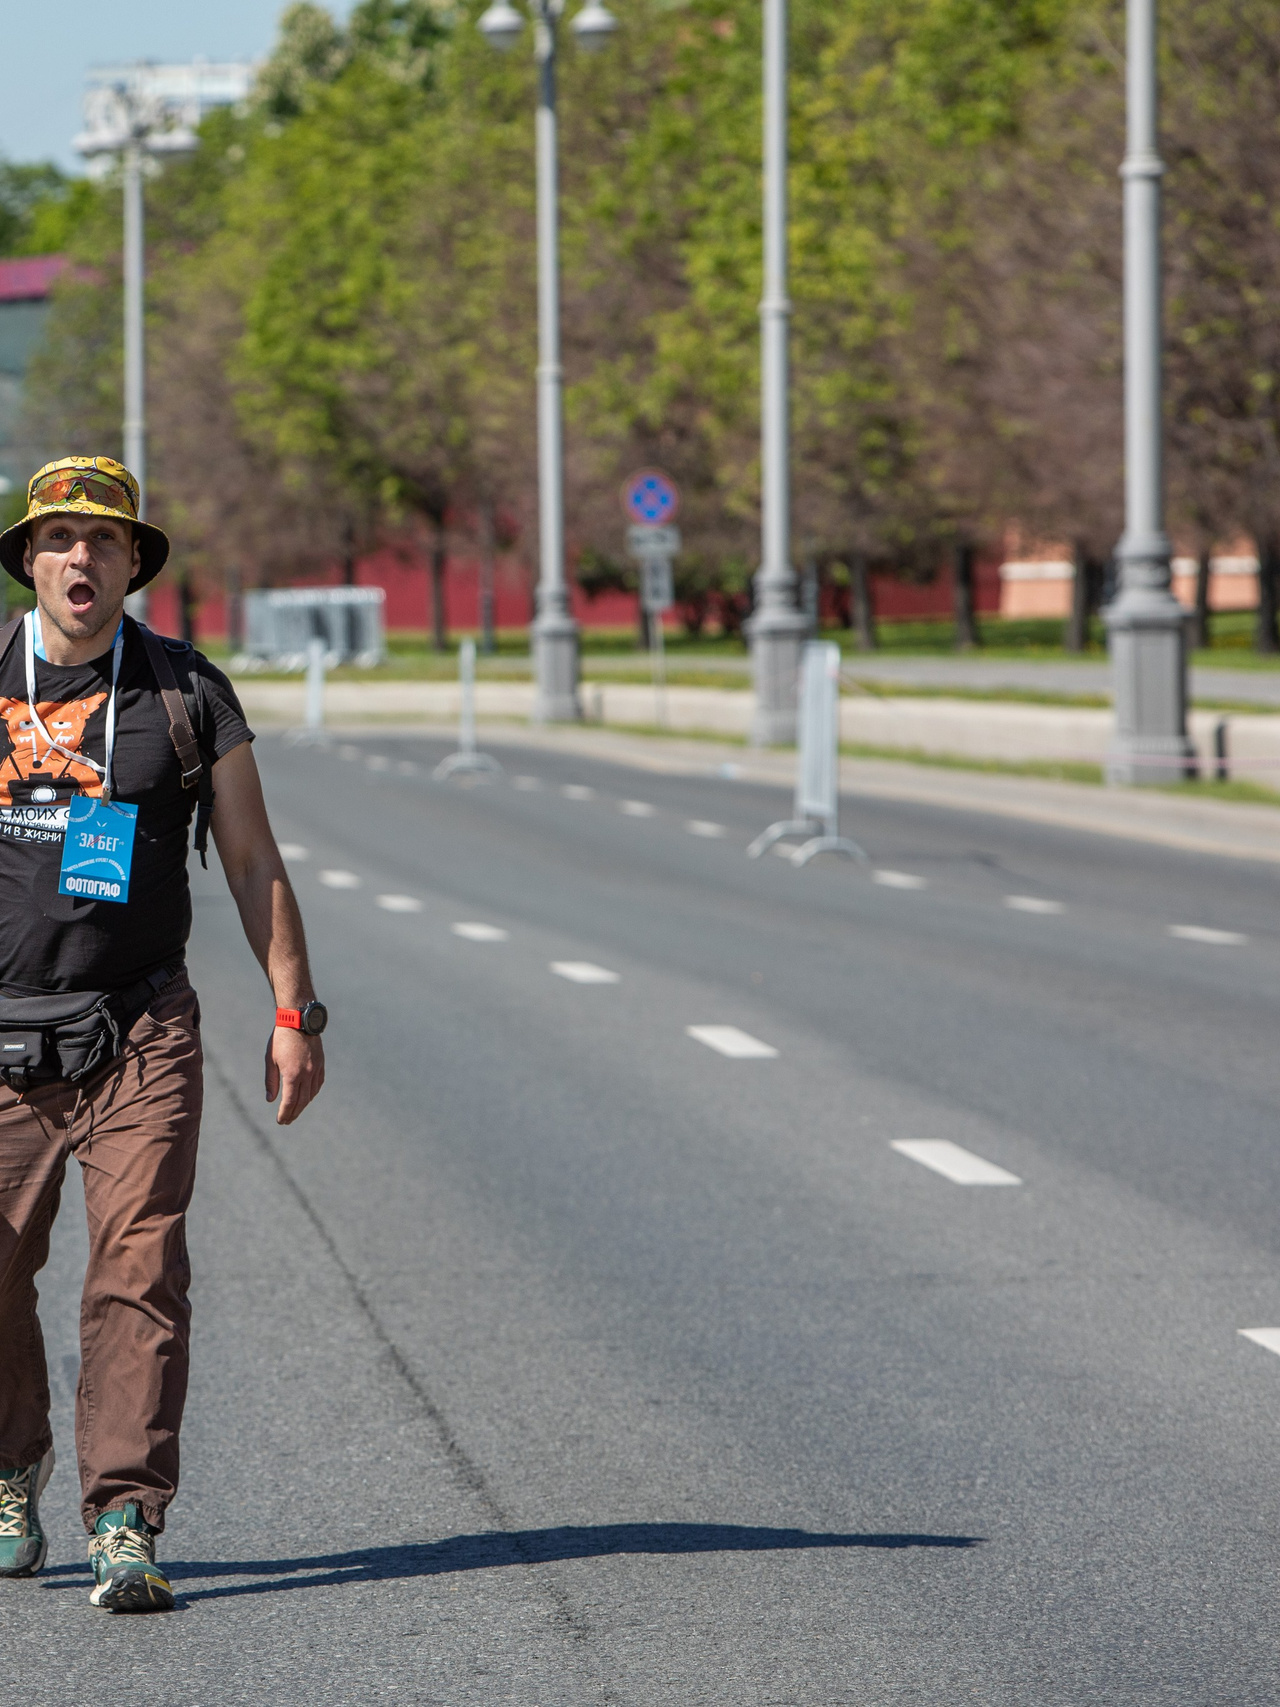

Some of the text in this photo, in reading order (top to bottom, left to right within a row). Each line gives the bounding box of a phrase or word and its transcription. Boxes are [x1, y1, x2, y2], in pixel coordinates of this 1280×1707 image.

[11, 807, 58, 821] МОИХ
[3, 825, 11, 835] И
[13, 826, 21, 836] В
[23, 828, 62, 843] ЖИЗНИ
[65, 876, 121, 898] ФОТОГРАФ
